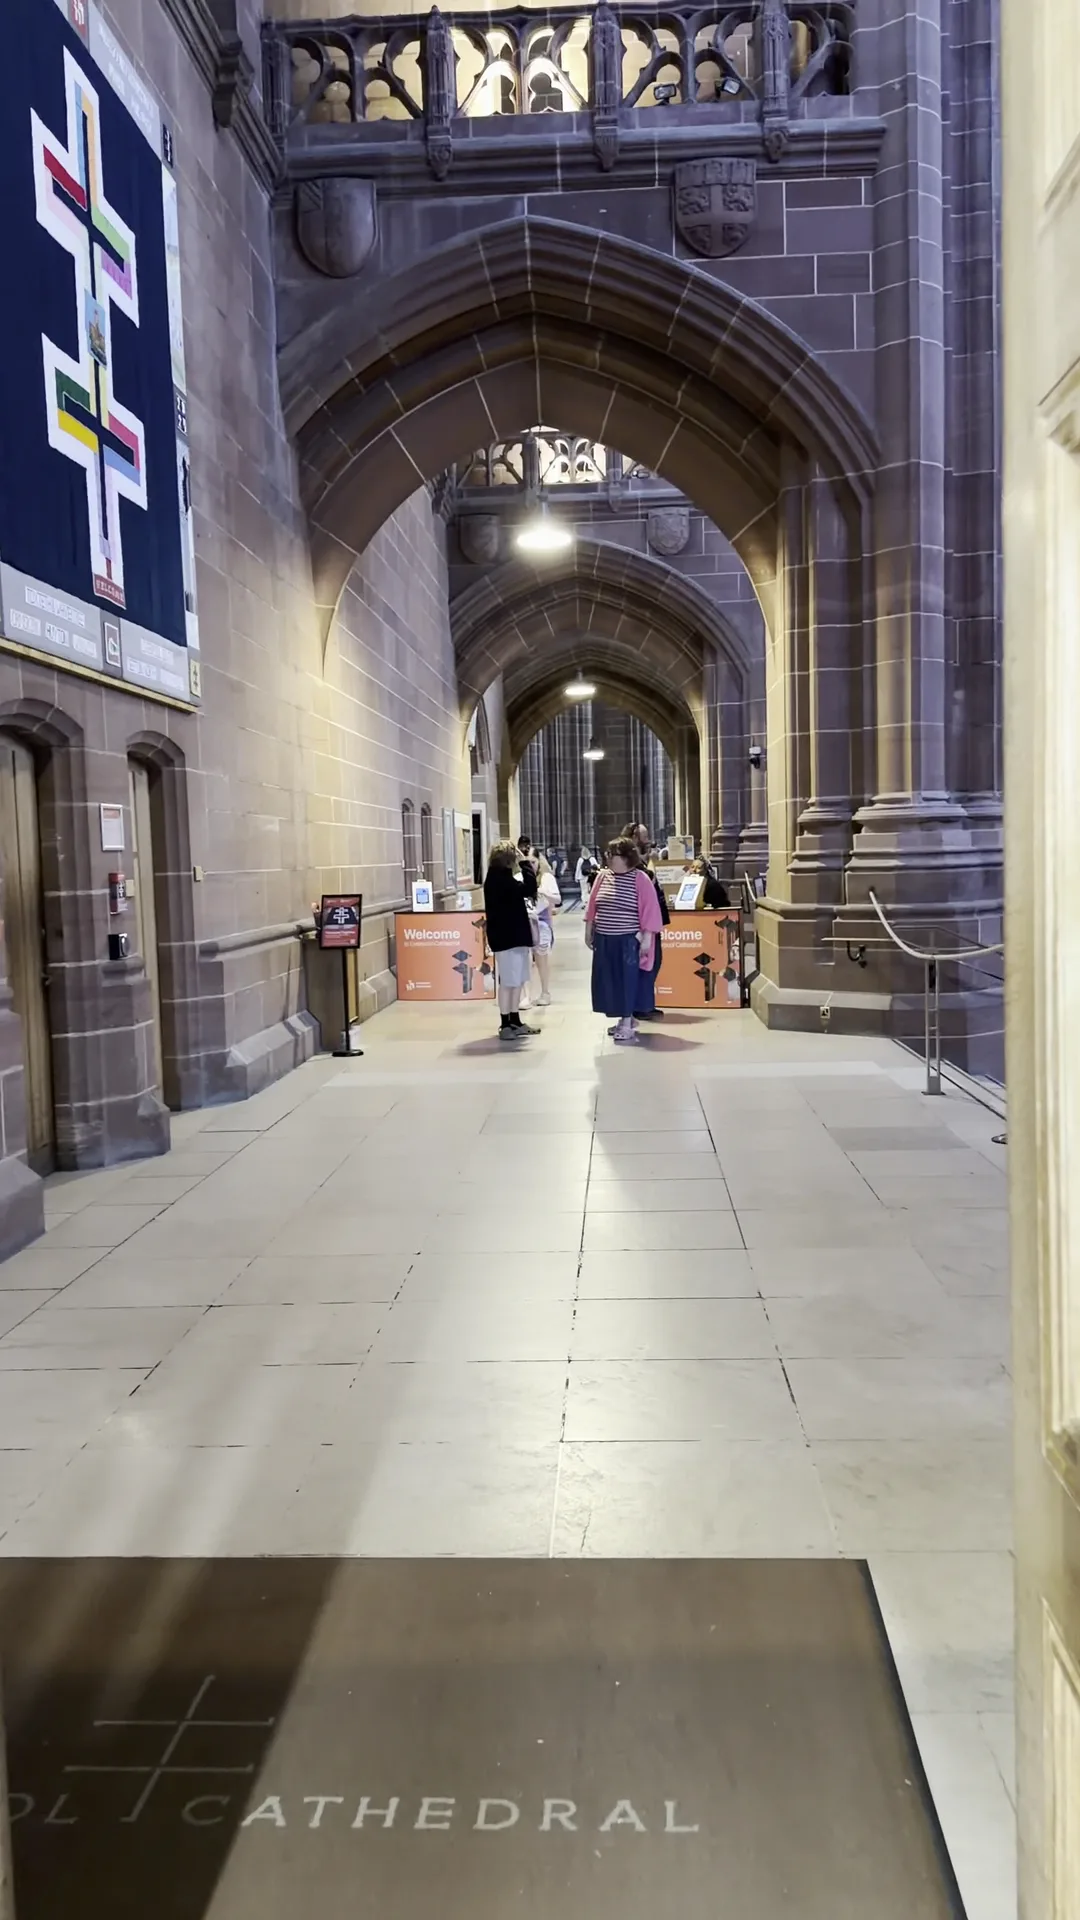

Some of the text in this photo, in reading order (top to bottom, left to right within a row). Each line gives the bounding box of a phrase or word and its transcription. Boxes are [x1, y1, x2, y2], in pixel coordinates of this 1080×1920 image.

[403, 929, 461, 940] Welcome
[660, 928, 703, 941] lcome
[181, 1795, 700, 1833] CATHEDRAL
